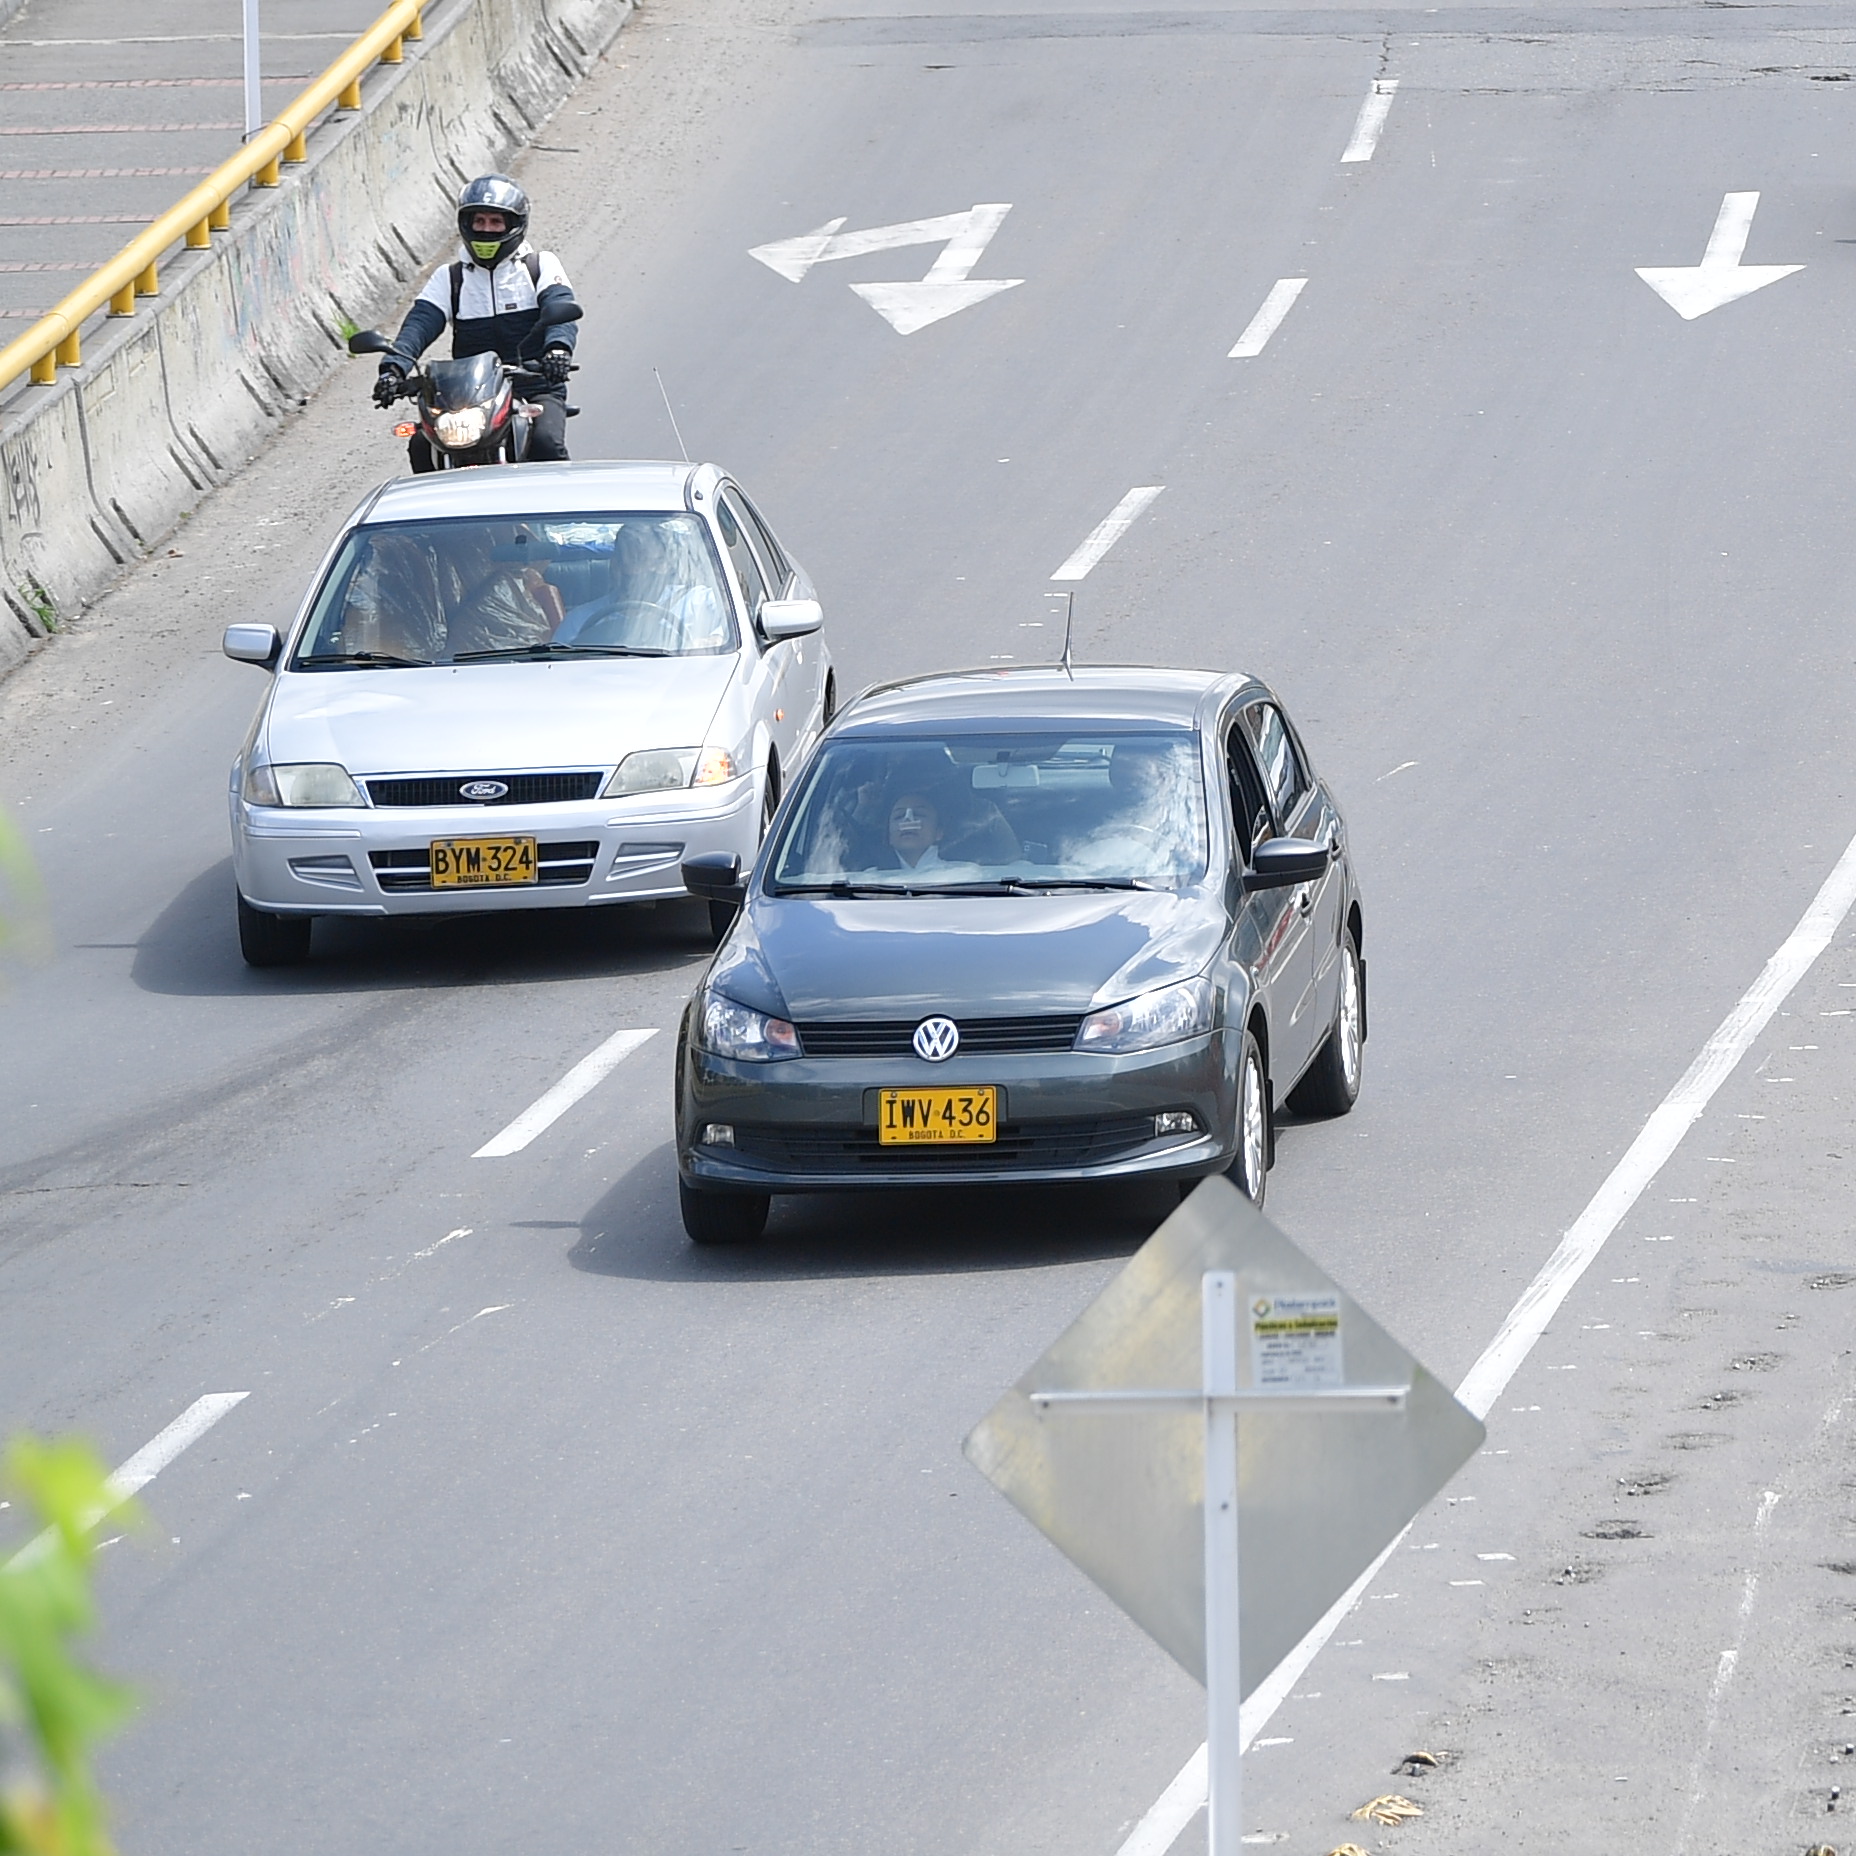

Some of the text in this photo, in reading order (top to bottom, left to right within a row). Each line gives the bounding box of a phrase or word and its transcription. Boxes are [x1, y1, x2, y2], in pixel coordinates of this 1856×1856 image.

[470, 783, 497, 795] Ford
[457, 874, 490, 884] BOGOTA
[908, 1129, 944, 1140] BOGOTA
